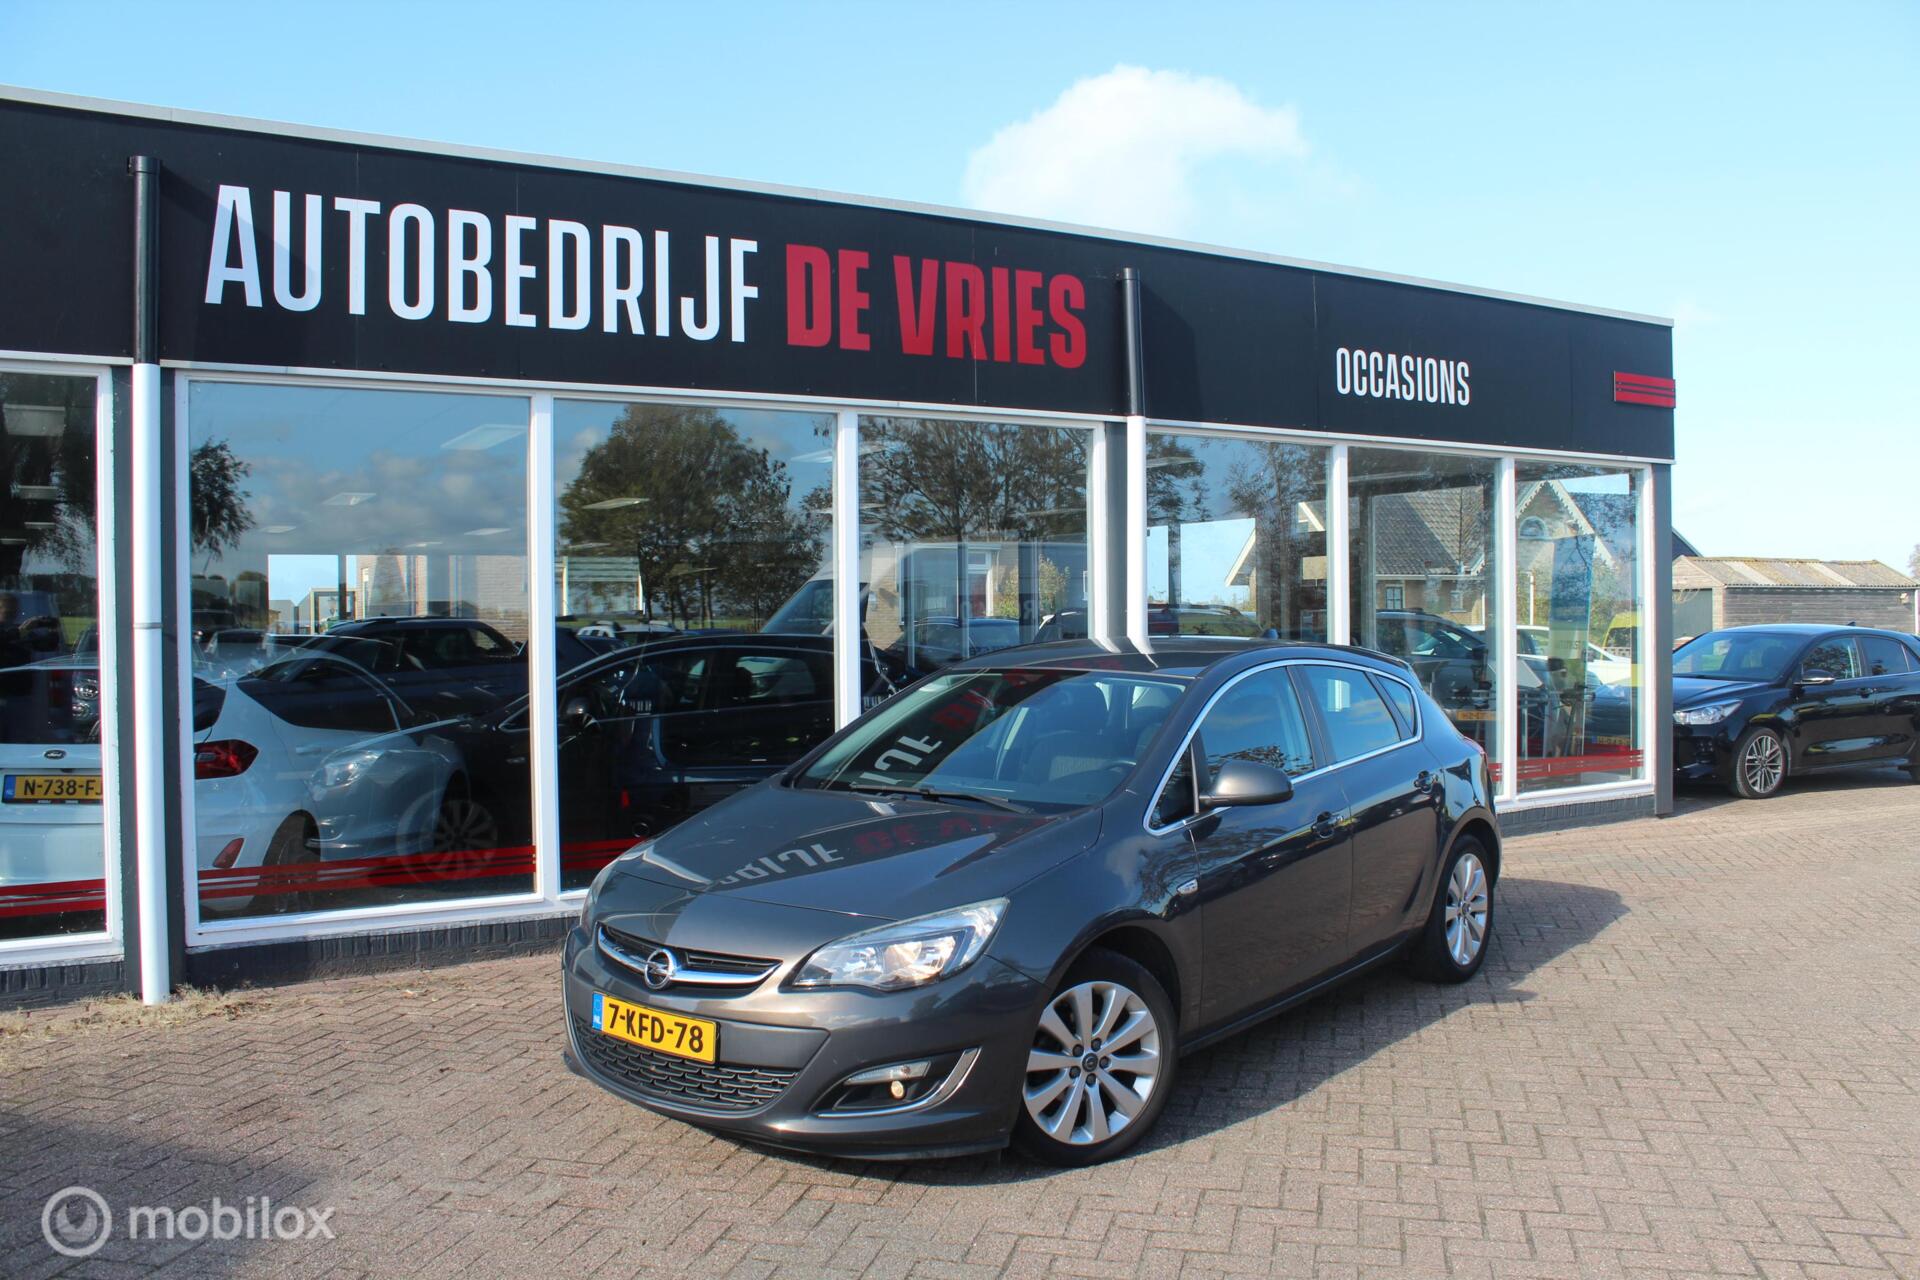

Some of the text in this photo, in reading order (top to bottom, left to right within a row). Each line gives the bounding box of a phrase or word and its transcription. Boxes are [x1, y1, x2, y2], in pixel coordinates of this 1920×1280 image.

[204, 184, 1087, 370] AUTOBEDRIJF DE VRIES
[1336, 347, 1470, 406] OCCASIONS
[608, 1002, 704, 1053] 7-KFD-78
